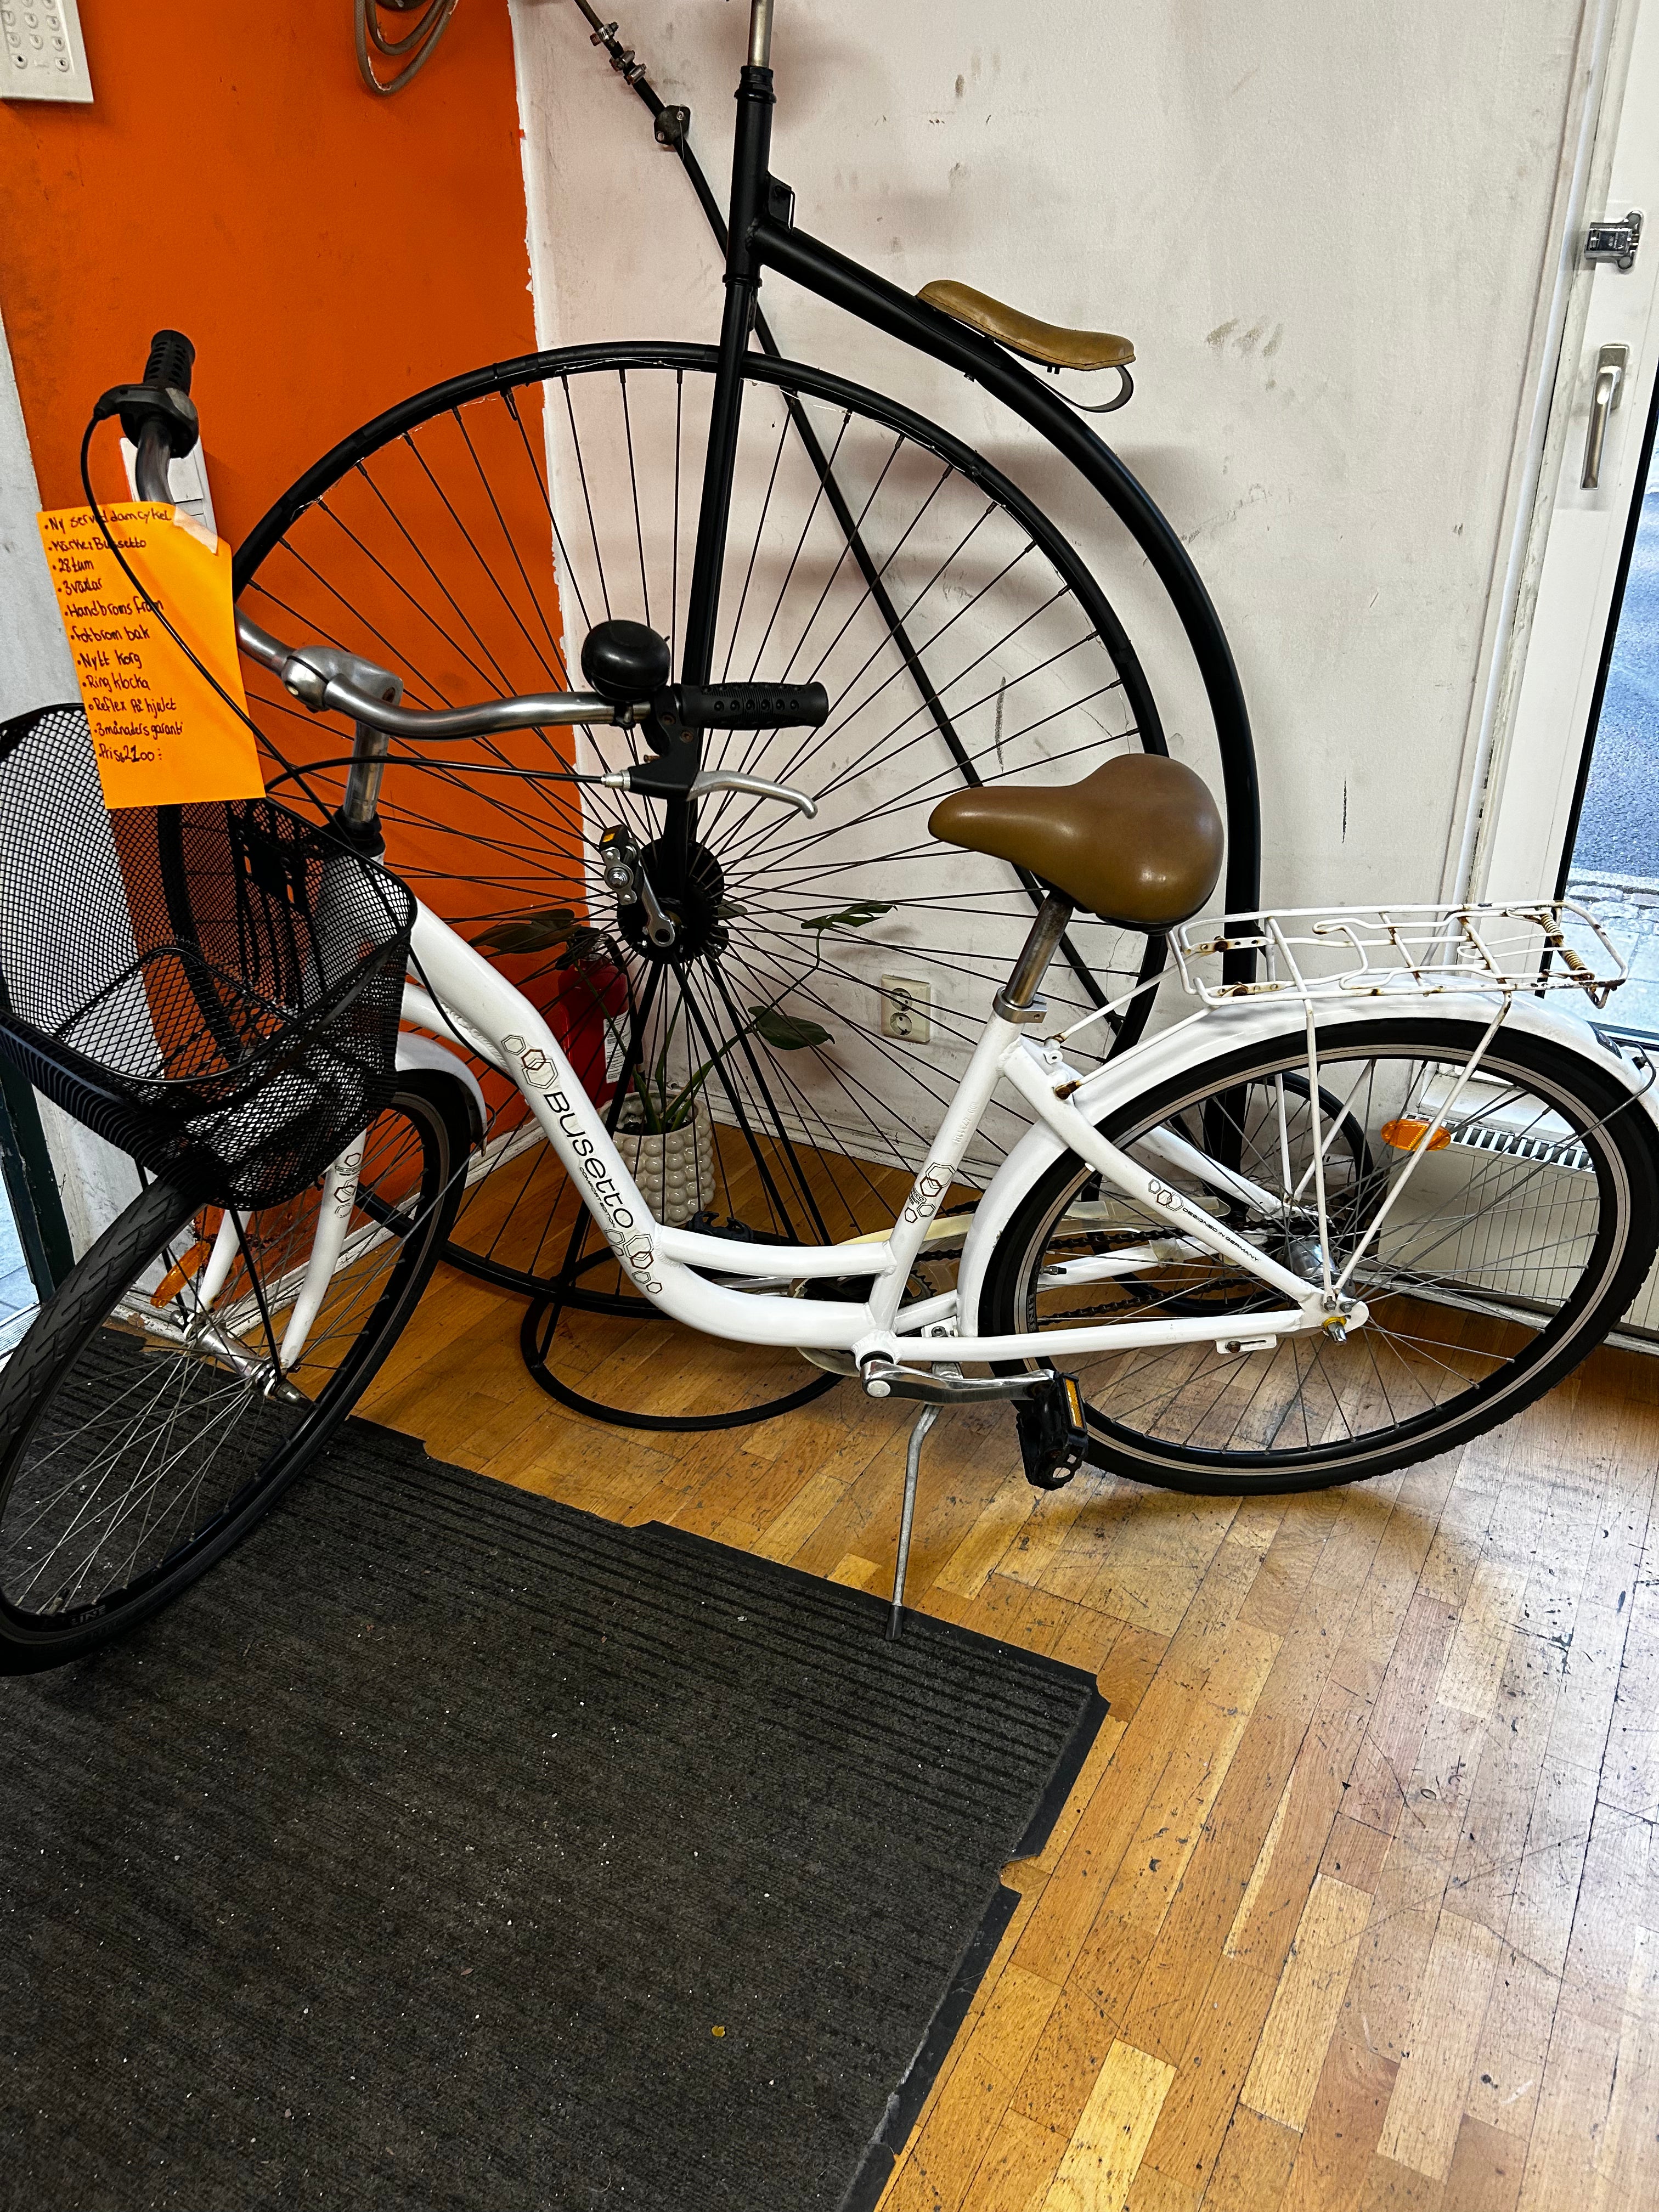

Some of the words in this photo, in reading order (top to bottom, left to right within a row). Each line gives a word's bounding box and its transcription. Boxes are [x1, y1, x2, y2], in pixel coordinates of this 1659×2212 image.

[49, 517, 65, 534] Ny
[123, 624, 150, 641] bak
[80, 650, 110, 671] Nytt
[543, 1091, 634, 1228] Busetto
[579, 1167, 602, 1201] COMFORT
[600, 1203, 617, 1228] EDITION
[1182, 1207, 1217, 1232] DESIGNED
[1225, 1237, 1260, 1261] GERMANY
